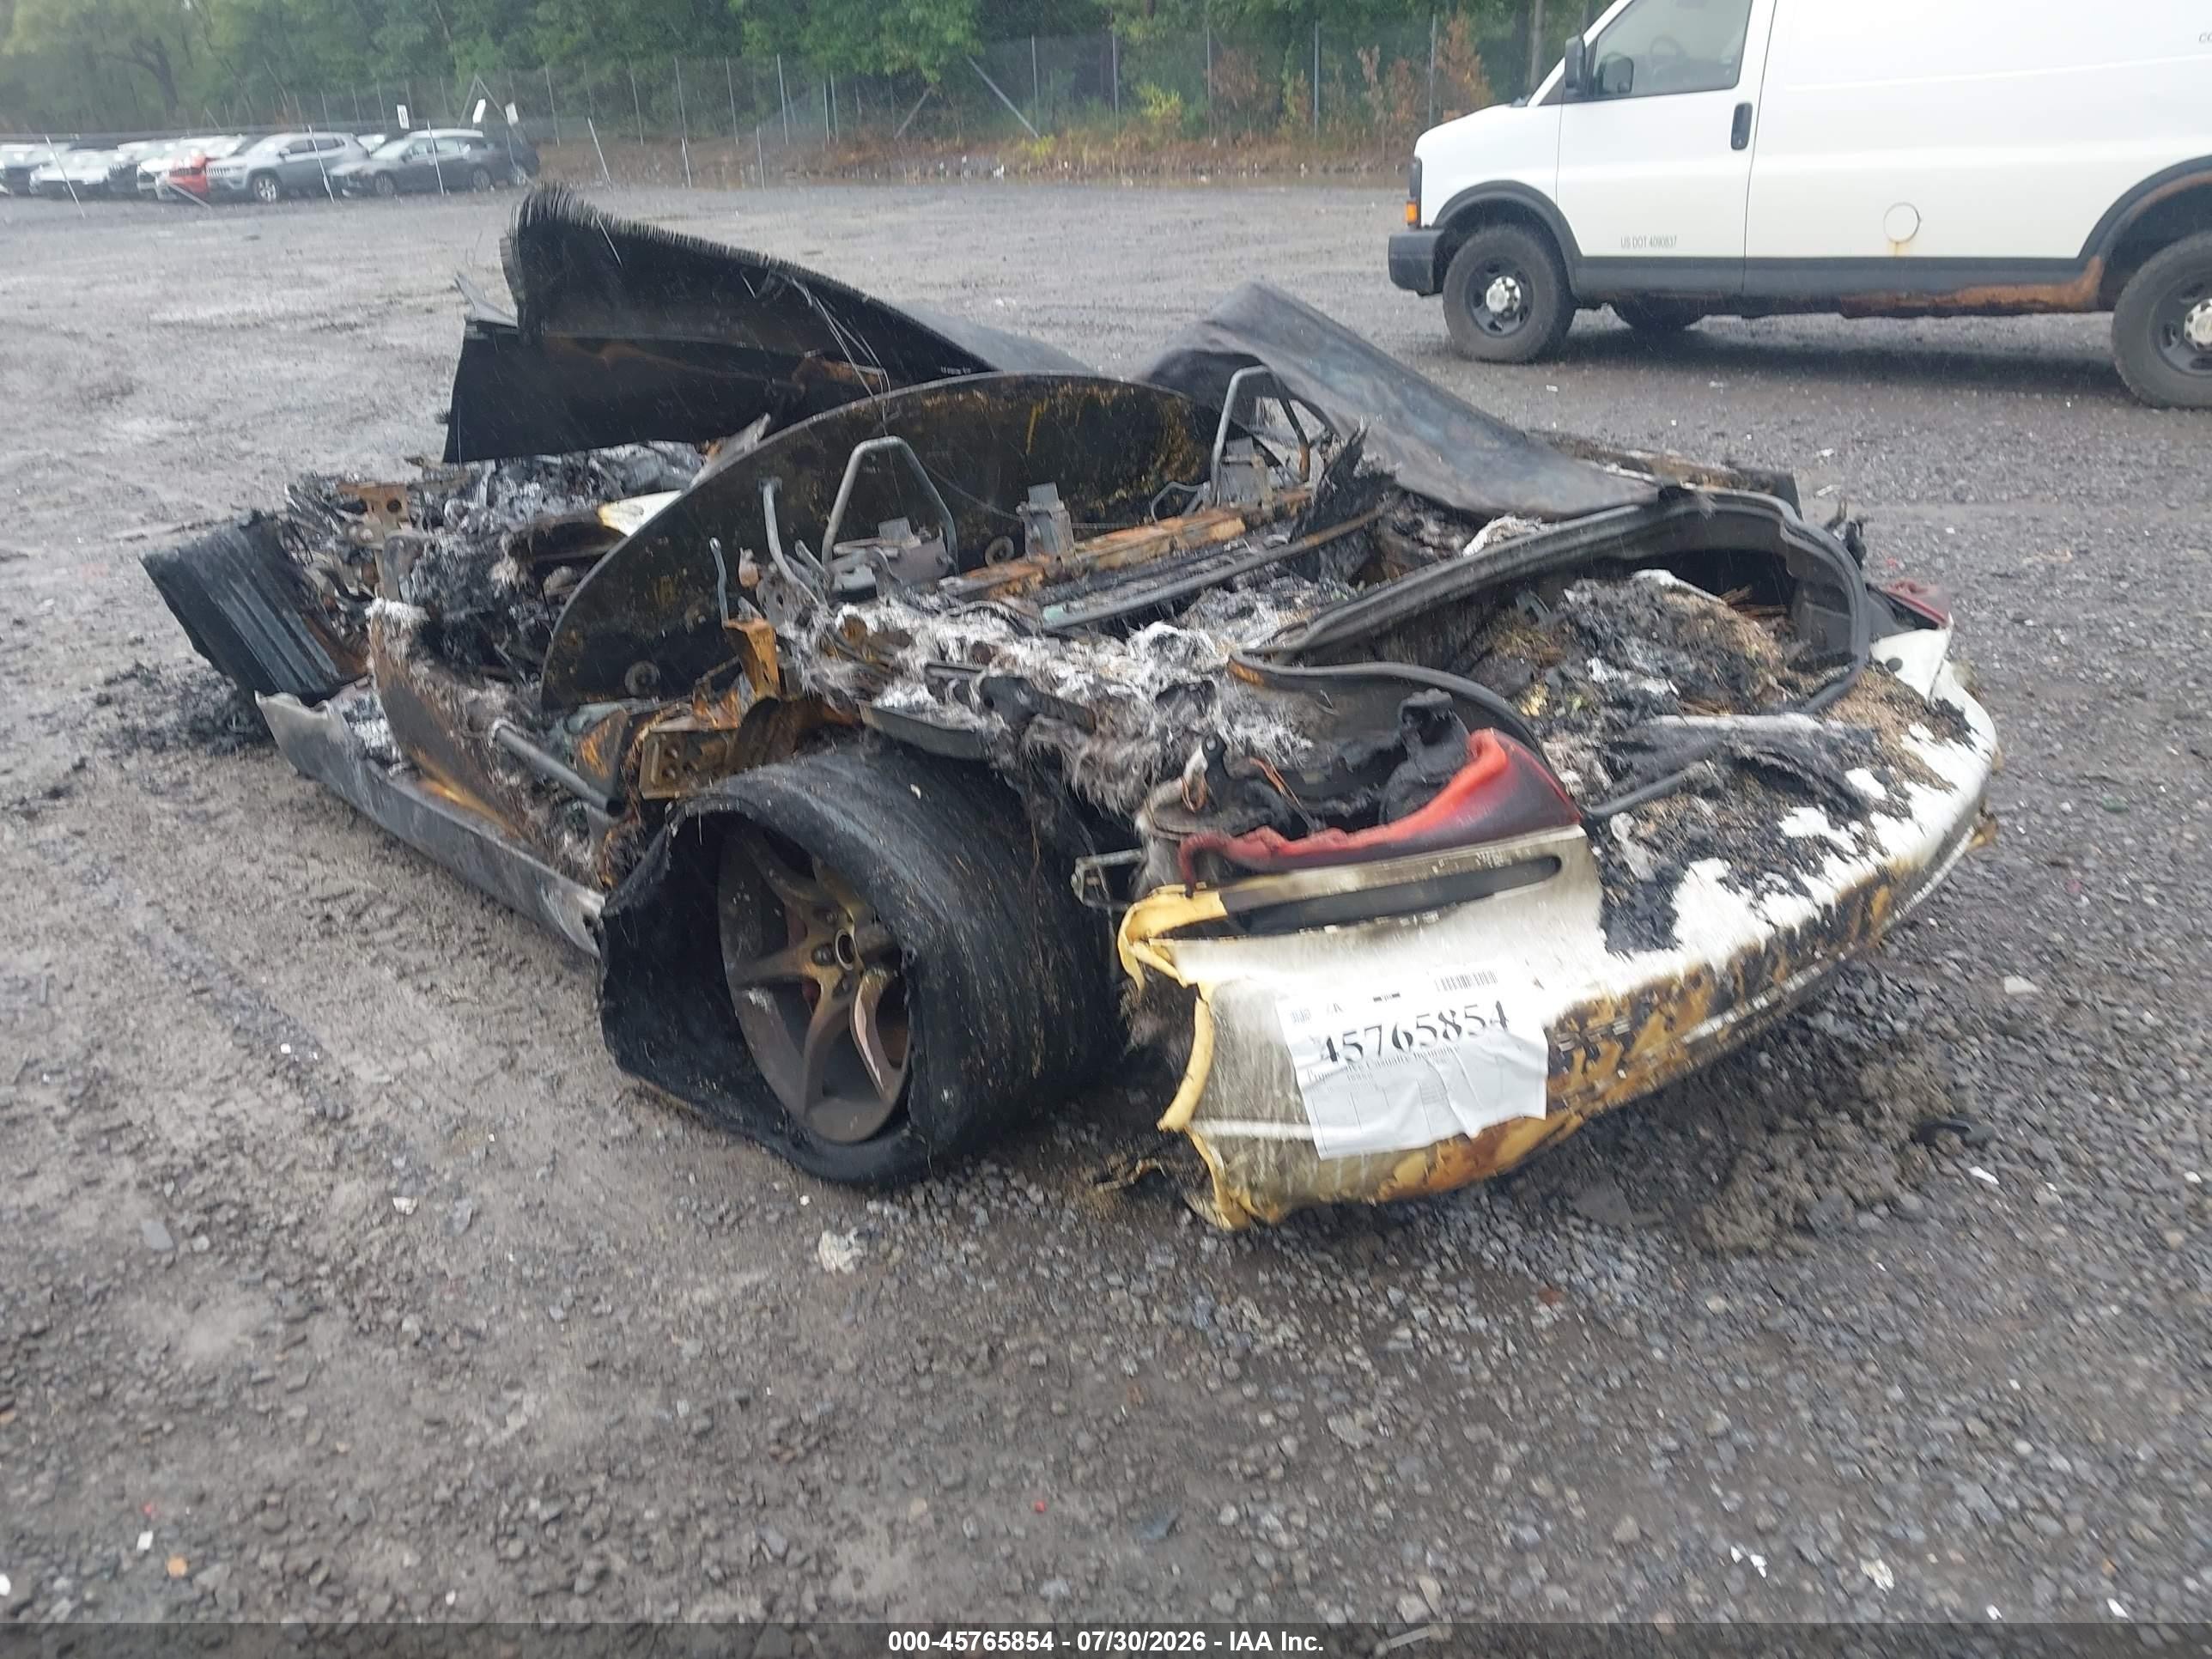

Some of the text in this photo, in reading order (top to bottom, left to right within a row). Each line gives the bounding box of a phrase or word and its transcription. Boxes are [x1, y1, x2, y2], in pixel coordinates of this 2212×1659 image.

[1620, 234, 1632, 249] US
[1632, 234, 1647, 249] DOT
[1320, 1000, 1510, 1064] 45765854
